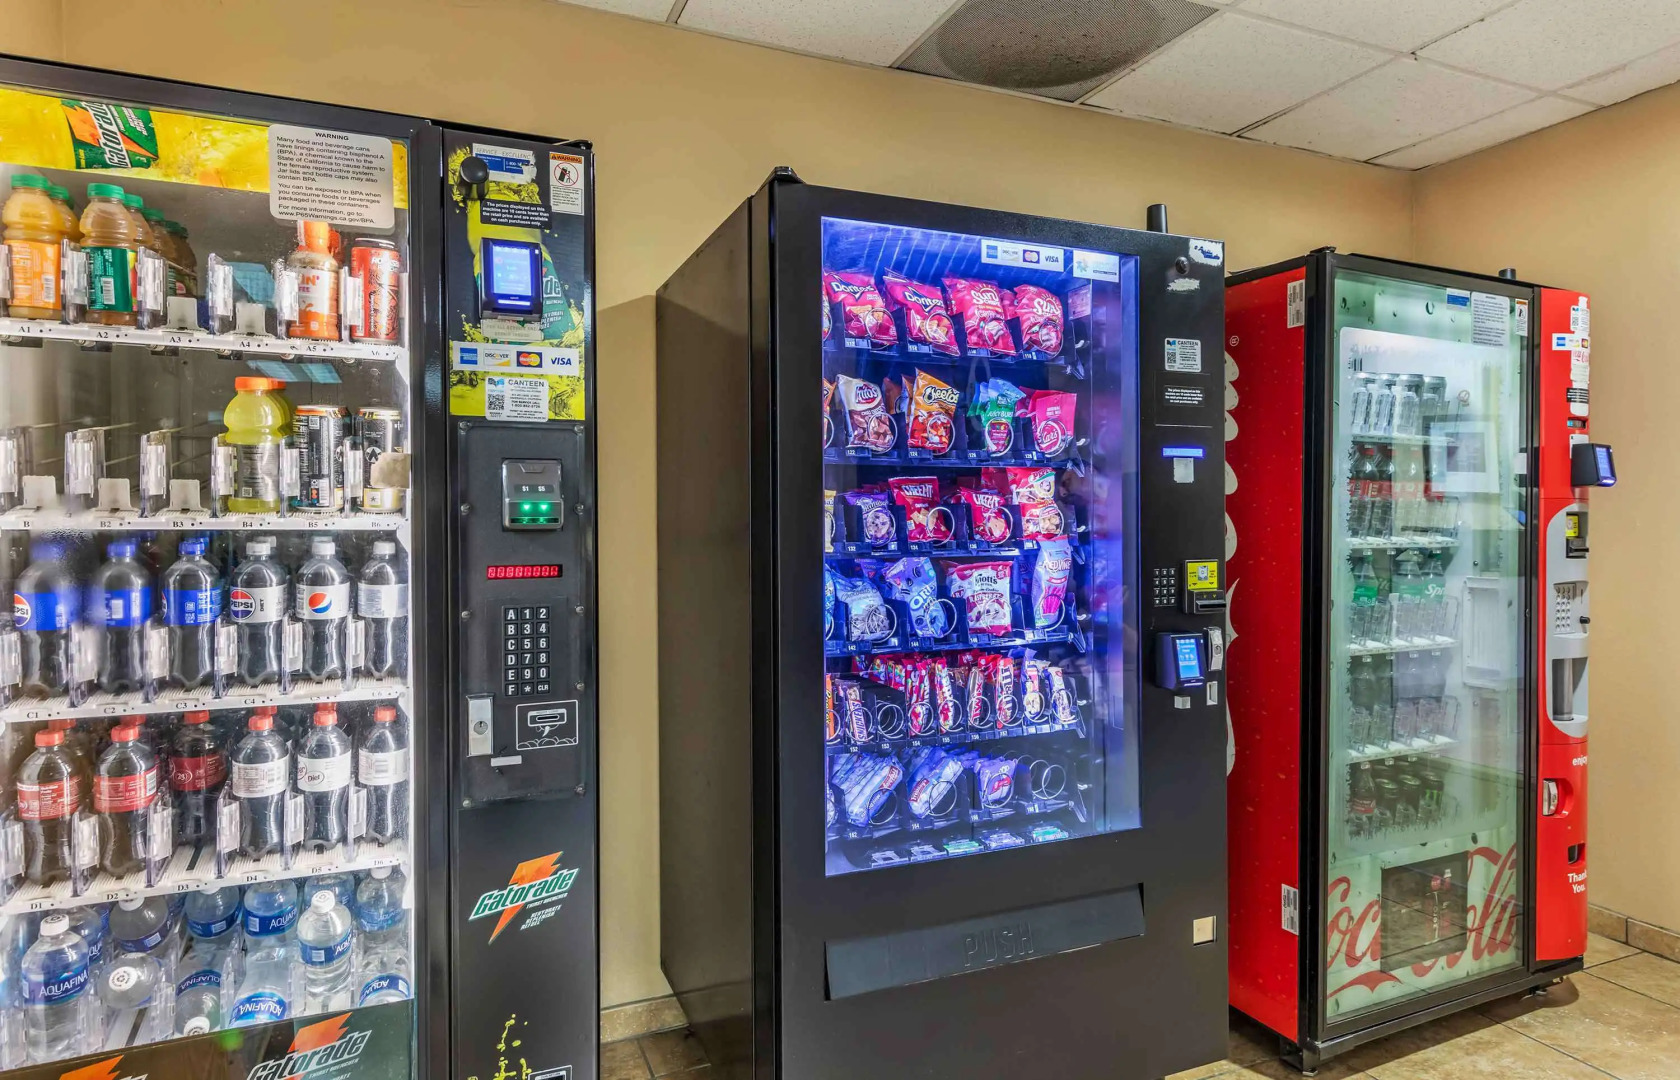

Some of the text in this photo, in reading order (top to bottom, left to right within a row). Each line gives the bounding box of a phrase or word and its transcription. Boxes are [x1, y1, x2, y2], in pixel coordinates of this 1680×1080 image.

[315, 132, 349, 140] WARNING
[325, 142, 354, 150] beverage
[316, 148, 348, 156] containing
[350, 151, 378, 159] bisphenol
[349, 196, 380, 204] beverages
[1045, 255, 1059, 263] VISA
[830, 281, 875, 296] Doritos
[904, 290, 944, 308] Doritos
[971, 288, 998, 304] Sun
[1033, 298, 1060, 315] Sun
[551, 357, 572, 366] VISA
[508, 379, 545, 387] CANTEEN
[923, 386, 959, 404] Cheetos
[975, 574, 998, 585] Knott's
[231, 601, 253, 609] PEPSI
[507, 610, 515, 620] A
[525, 609, 530, 618] 1
[540, 609, 546, 618] 2
[508, 625, 515, 634] B
[524, 624, 530, 633] 3
[539, 624, 546, 633] 4
[508, 640, 515, 650] C
[524, 639, 530, 649] 5
[540, 639, 546, 648] 6
[508, 655, 515, 664] D
[524, 654, 530, 664] 7
[540, 654, 546, 663] 8
[508, 670, 515, 680] E
[524, 670, 531, 679] 9
[540, 668, 546, 678] 0
[509, 685, 515, 695] F
[972, 682, 982, 722] TWIX
[852, 702, 866, 743] SNICKERS
[307, 774, 320, 782] Diet
[468, 868, 580, 921] Gatorade
[964, 921, 1034, 967] PUSH
[40, 970, 88, 998] AQUAFINA
[239, 1000, 284, 1016] AQUAFINA
[247, 1029, 372, 1080] Gatorade
